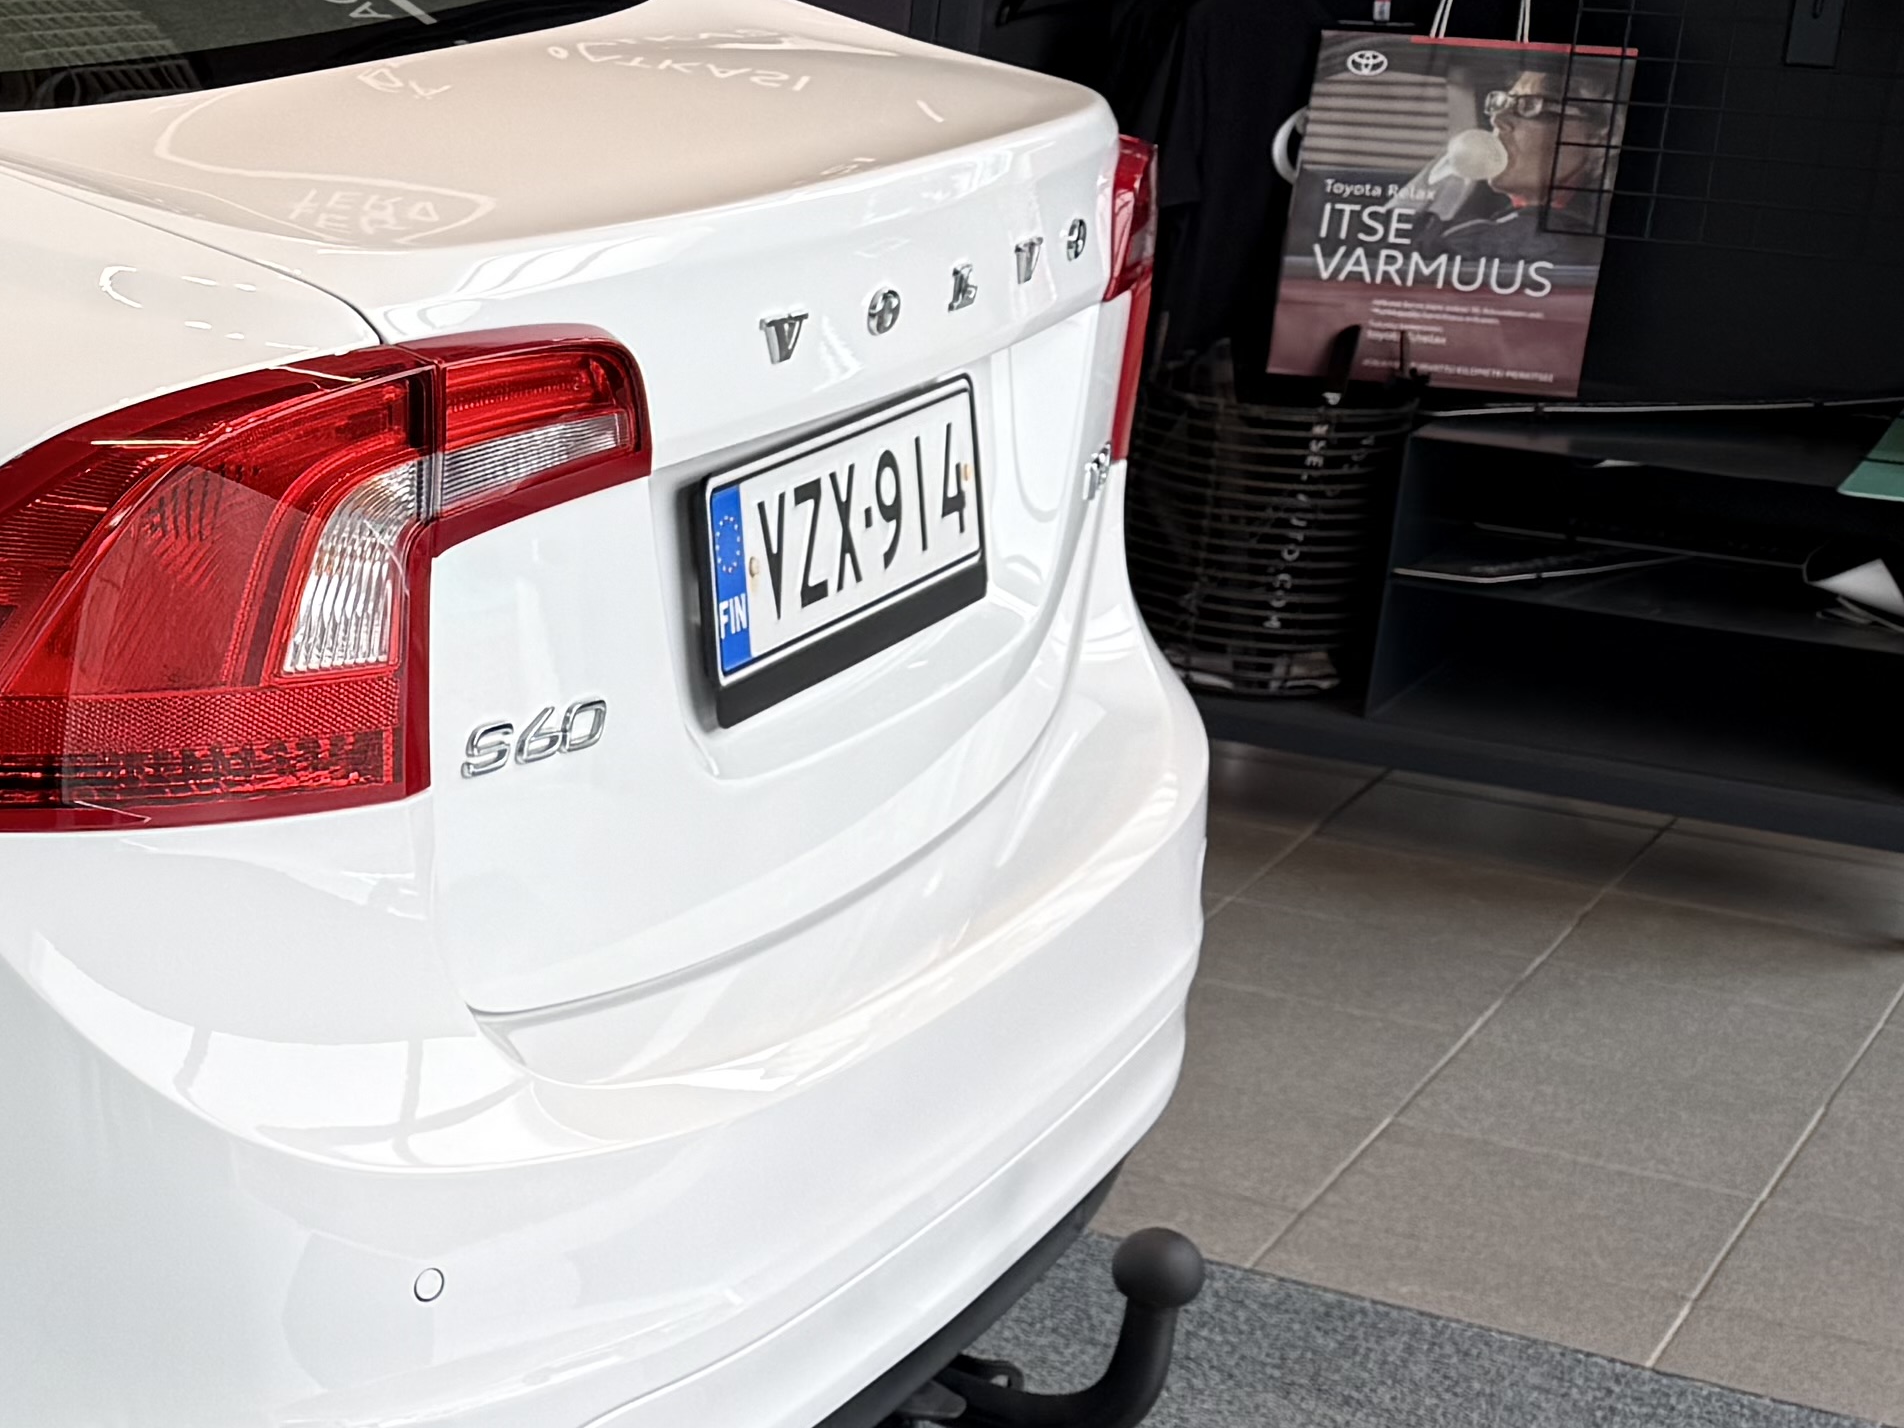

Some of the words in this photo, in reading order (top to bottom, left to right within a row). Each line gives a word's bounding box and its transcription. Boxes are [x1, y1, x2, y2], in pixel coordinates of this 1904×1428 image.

[1324, 179, 1382, 198] Toyota
[1388, 184, 1437, 200] Relax
[1319, 202, 1416, 245] ITSE
[759, 217, 1088, 364] VOLVO
[1313, 244, 1554, 297] VARMUUS
[756, 422, 967, 621] VZX-914
[718, 592, 748, 641] FIN
[460, 698, 607, 779] S60
